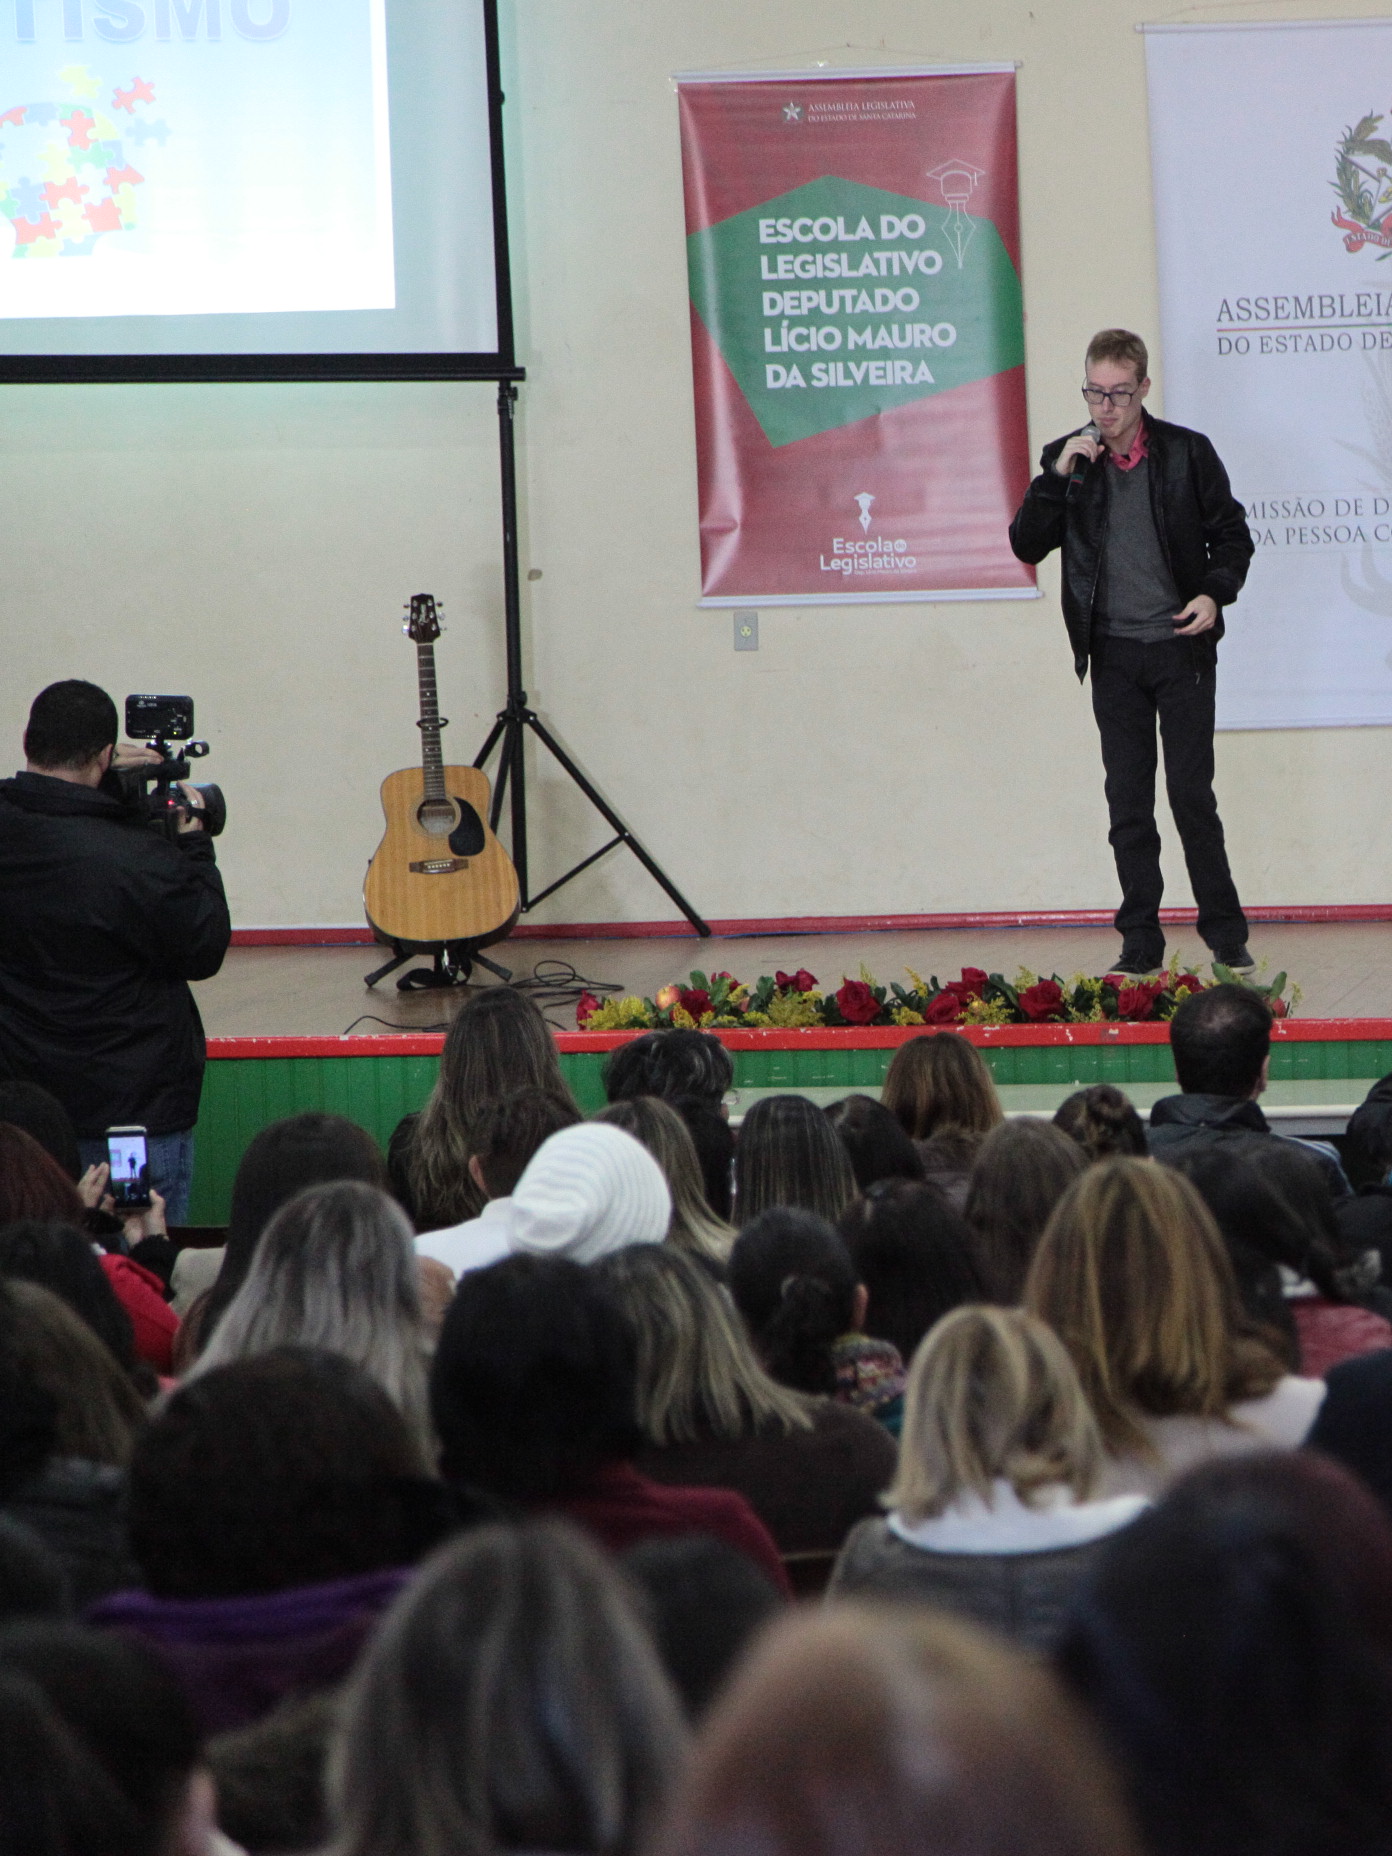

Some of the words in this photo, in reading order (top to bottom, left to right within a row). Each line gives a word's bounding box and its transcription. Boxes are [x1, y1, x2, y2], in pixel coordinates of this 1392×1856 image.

[862, 100, 916, 111] LEGISLATIVA
[758, 215, 876, 244] ESCOLA
[880, 213, 926, 241] DO
[760, 250, 943, 280] LEGISLATIVO
[762, 287, 920, 316] DEPUTADO
[763, 319, 842, 353] LÍCIO
[847, 322, 957, 350] MAURO
[1216, 336, 1251, 356] DO
[1259, 332, 1353, 355] ESTADO
[765, 363, 807, 390] DA
[810, 359, 935, 387] SILVEIRA
[1335, 498, 1364, 517] DE
[833, 536, 894, 554] Escola
[1285, 524, 1368, 545] PESSOA
[820, 551, 917, 576] Legislativo
